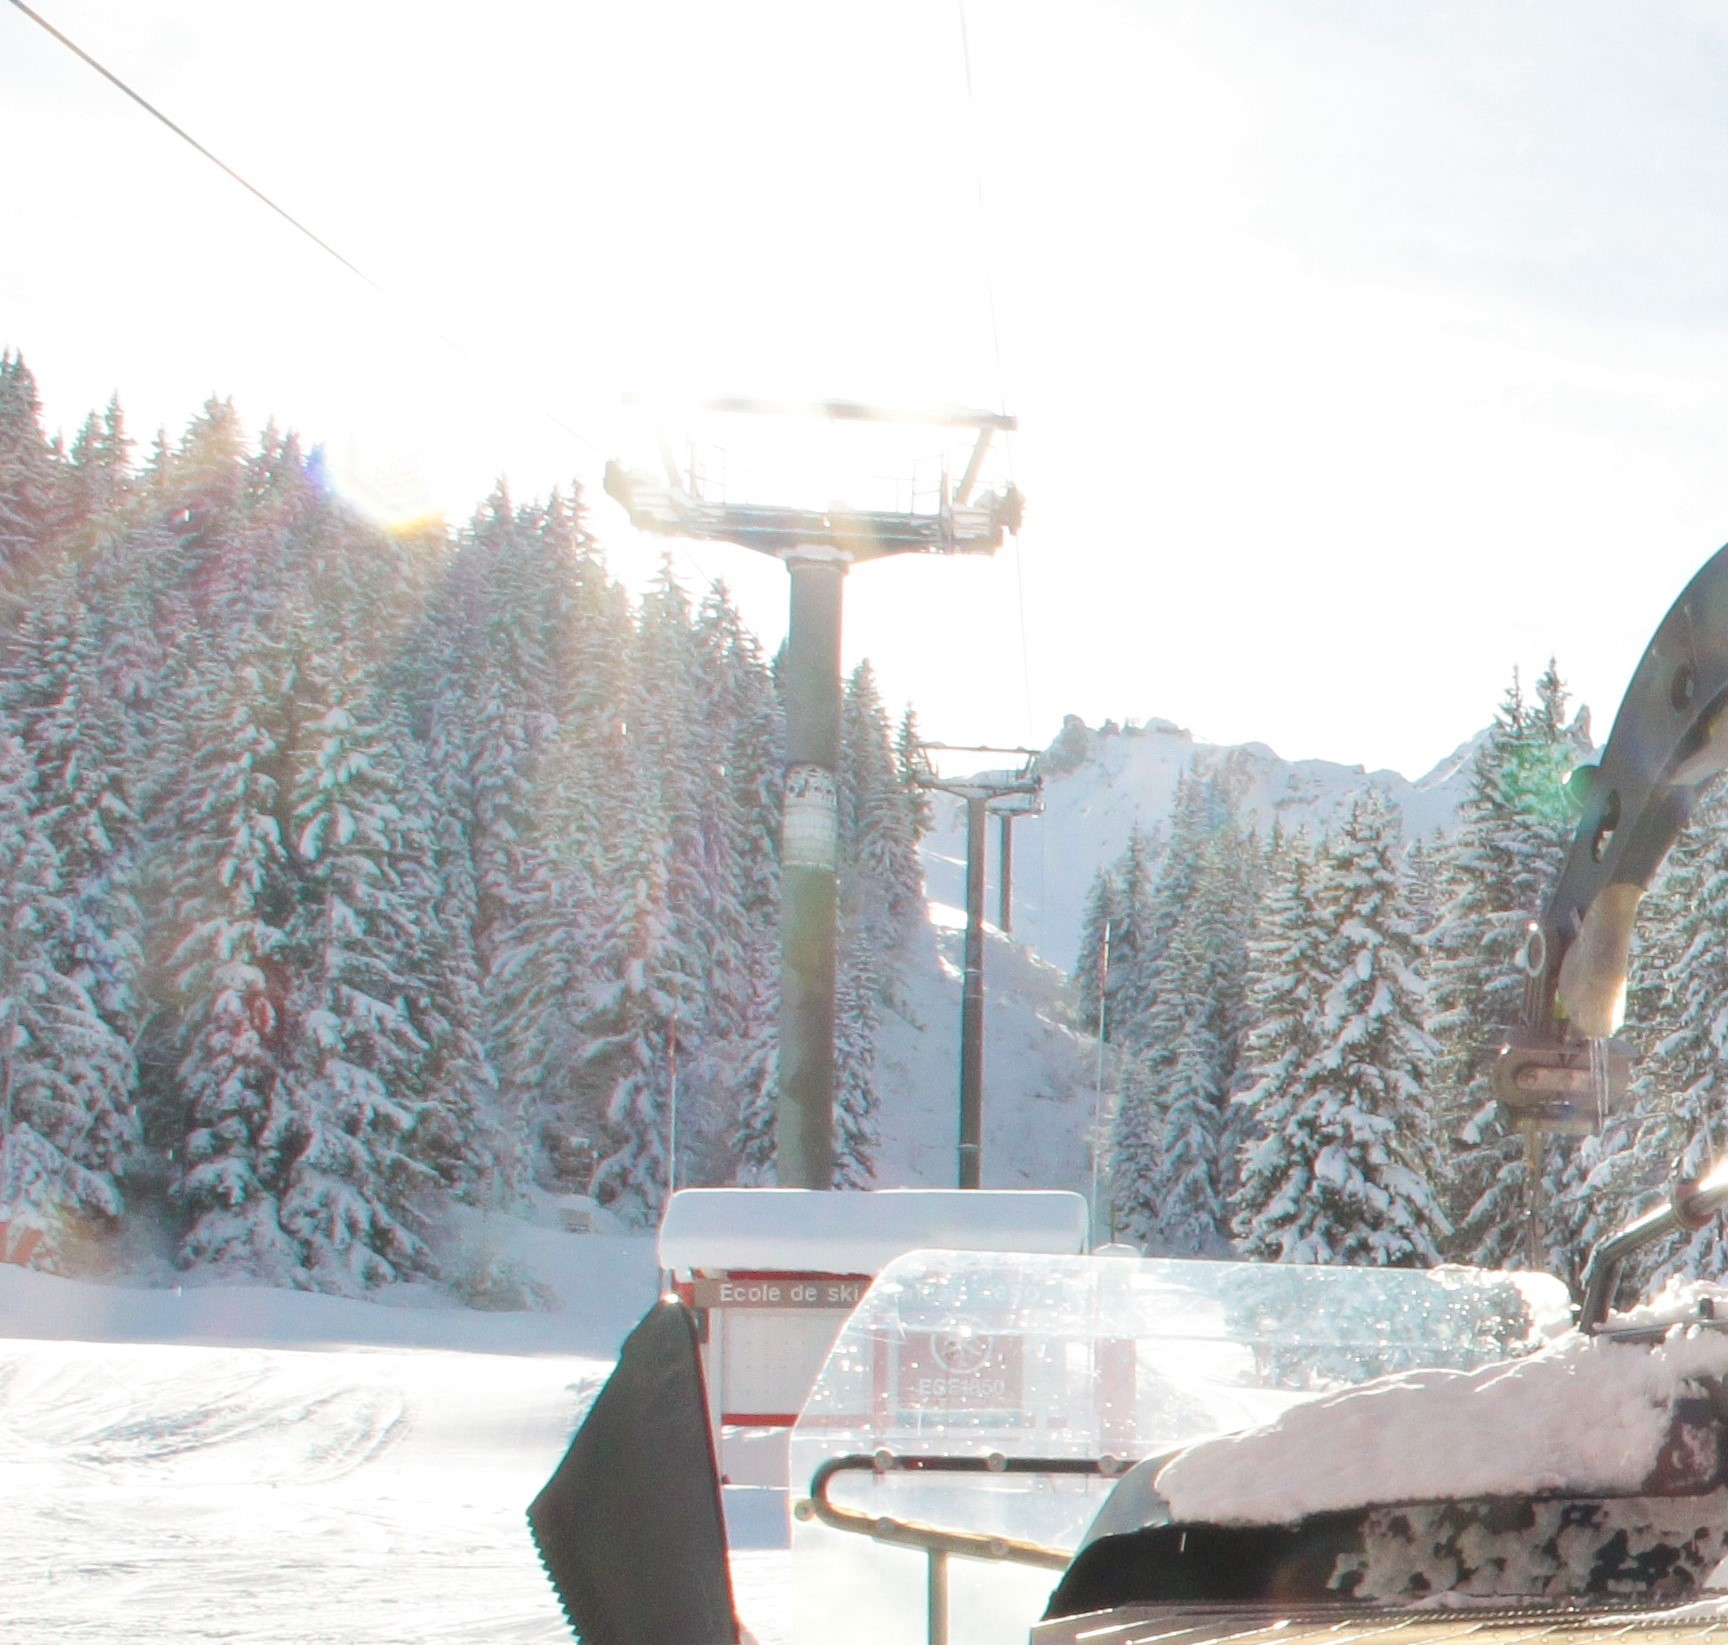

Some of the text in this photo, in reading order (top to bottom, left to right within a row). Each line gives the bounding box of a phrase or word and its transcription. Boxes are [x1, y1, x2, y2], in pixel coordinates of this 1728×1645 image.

[720, 1284, 861, 1302] Ecole de ski
